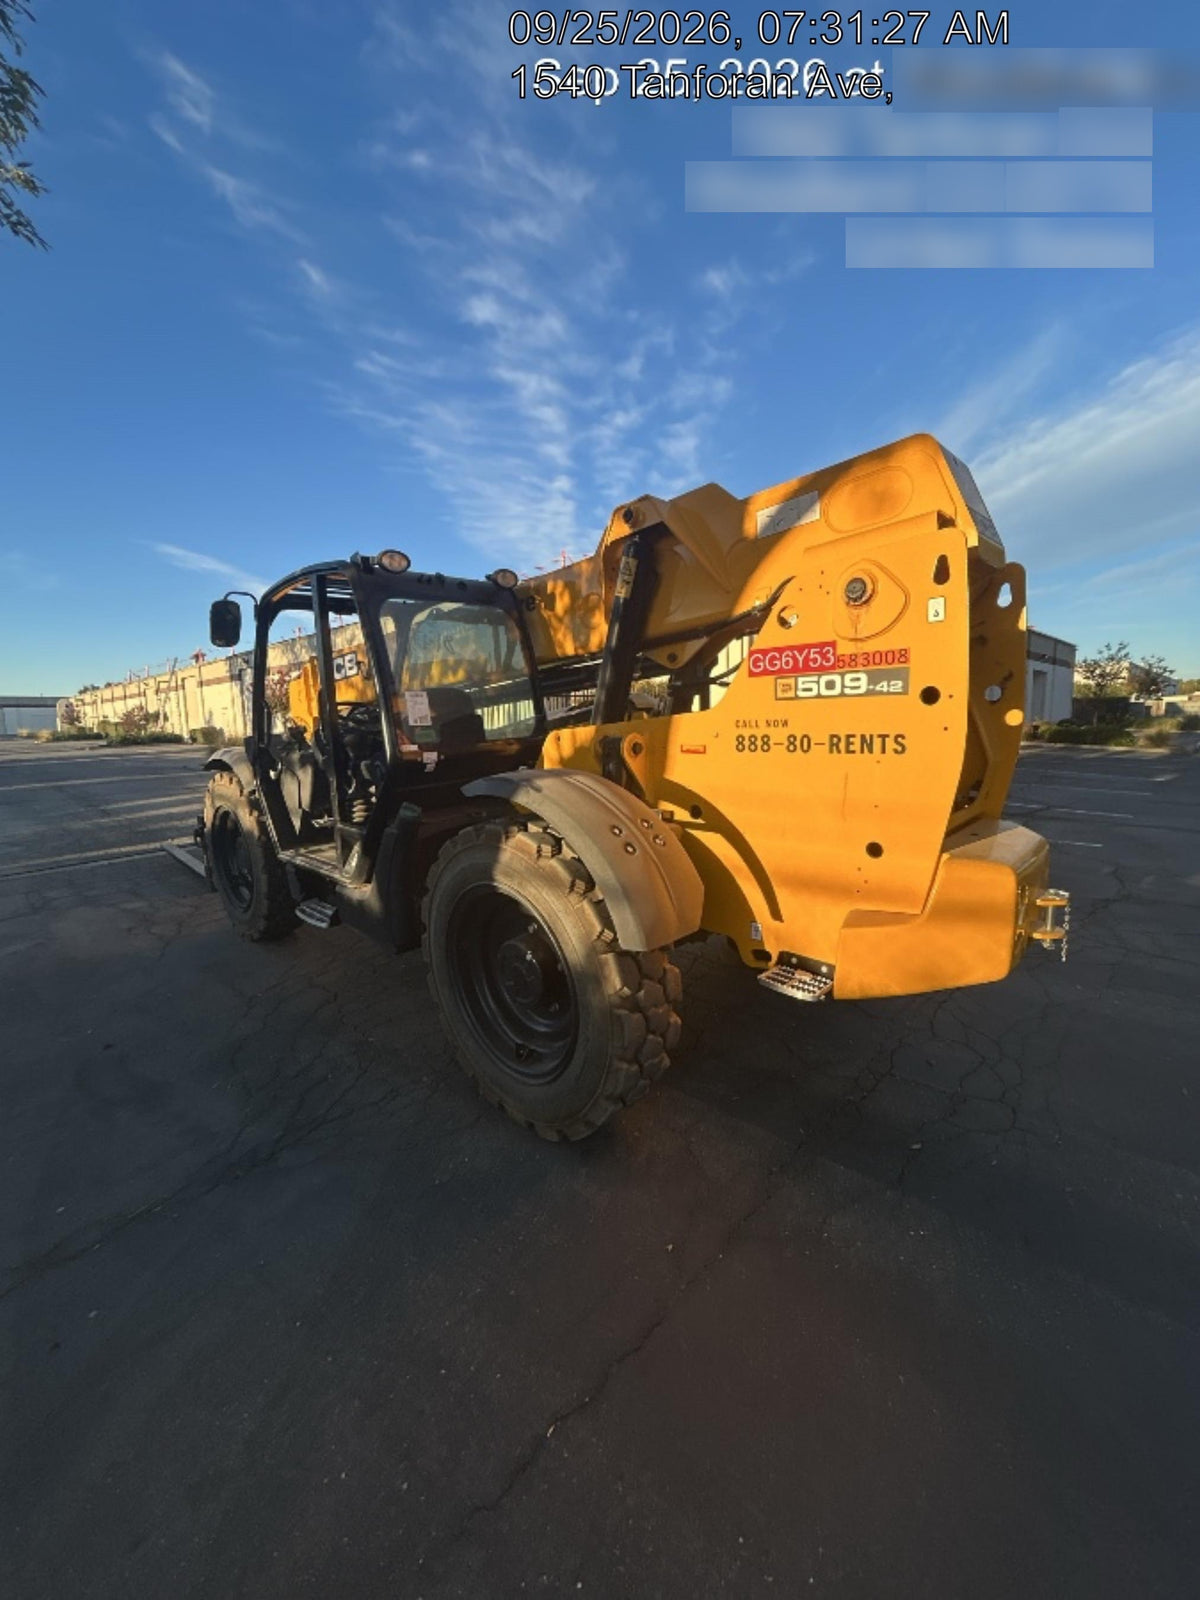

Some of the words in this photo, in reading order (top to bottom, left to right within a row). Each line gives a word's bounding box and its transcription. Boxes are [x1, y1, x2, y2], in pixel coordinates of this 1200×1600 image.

[333, 653, 358, 680] CB
[749, 647, 835, 673] GG6Y53
[837, 649, 908, 669] 583008
[735, 719, 760, 728] CALL
[765, 719, 789, 728] NOW
[735, 733, 907, 755] 888-80-RENTS
